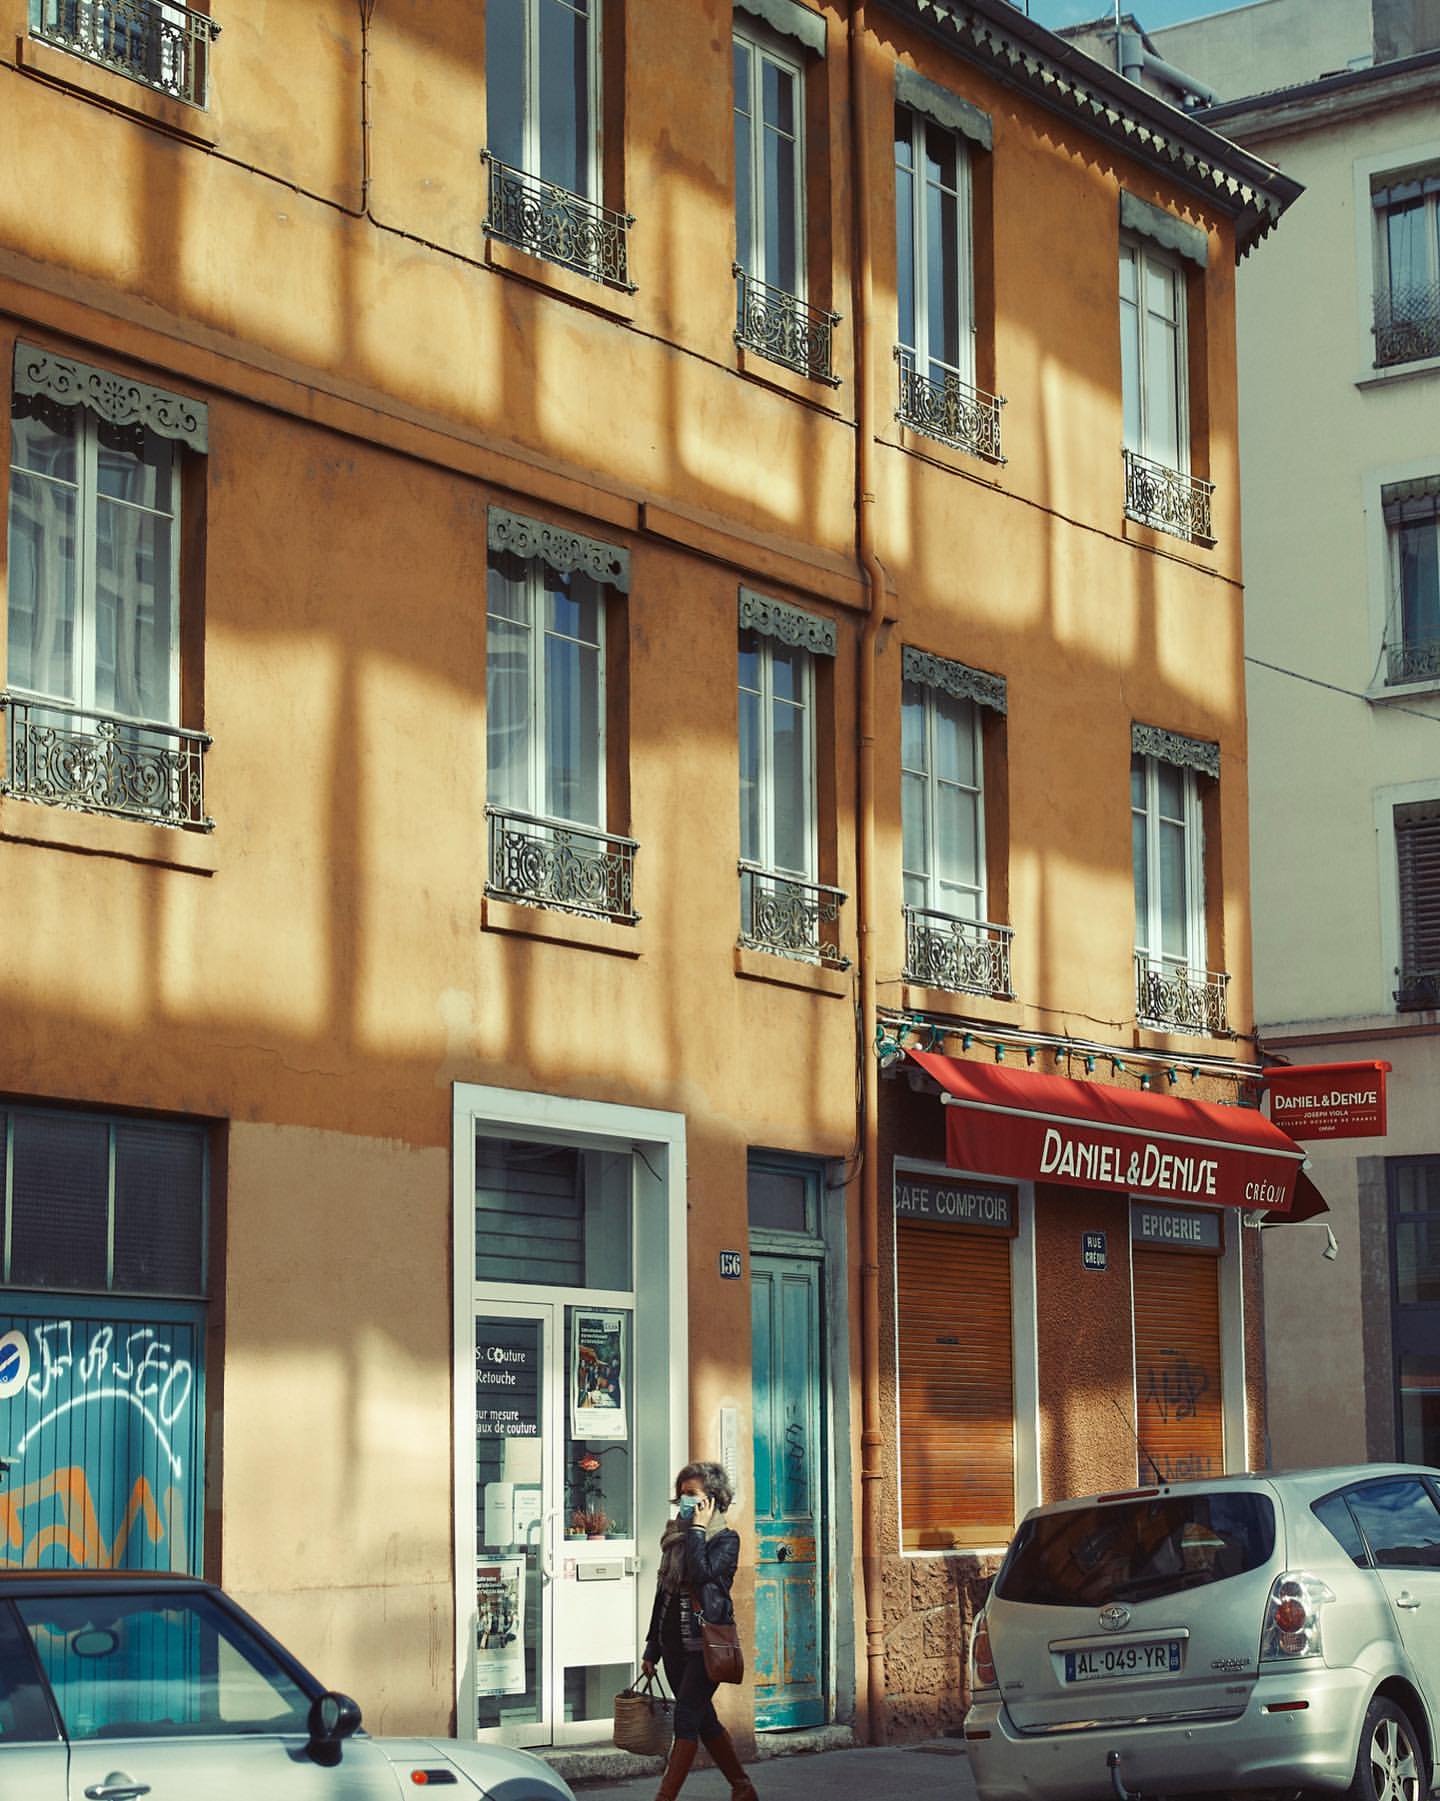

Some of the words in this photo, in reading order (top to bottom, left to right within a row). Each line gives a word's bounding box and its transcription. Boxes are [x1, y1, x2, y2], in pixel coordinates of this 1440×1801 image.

[1275, 1091, 1377, 1110] DANIEL&DENISE
[1304, 1111, 1328, 1119] JOSEPH
[1040, 1128, 1218, 1196] DANIEL&DENISE
[1245, 1179, 1287, 1204] CRÉQUI
[936, 1191, 1008, 1221] COMPTOIR
[1142, 1214, 1201, 1241] EPICERIE
[1087, 1236, 1102, 1249] RUE
[720, 1253, 740, 1276] 156
[476, 1369, 516, 1385] Retouche
[490, 1410, 520, 1421] mesure
[494, 1420, 505, 1433] de
[506, 1421, 537, 1435] couture
[1078, 1646, 1166, 1674] AL-049-YR
